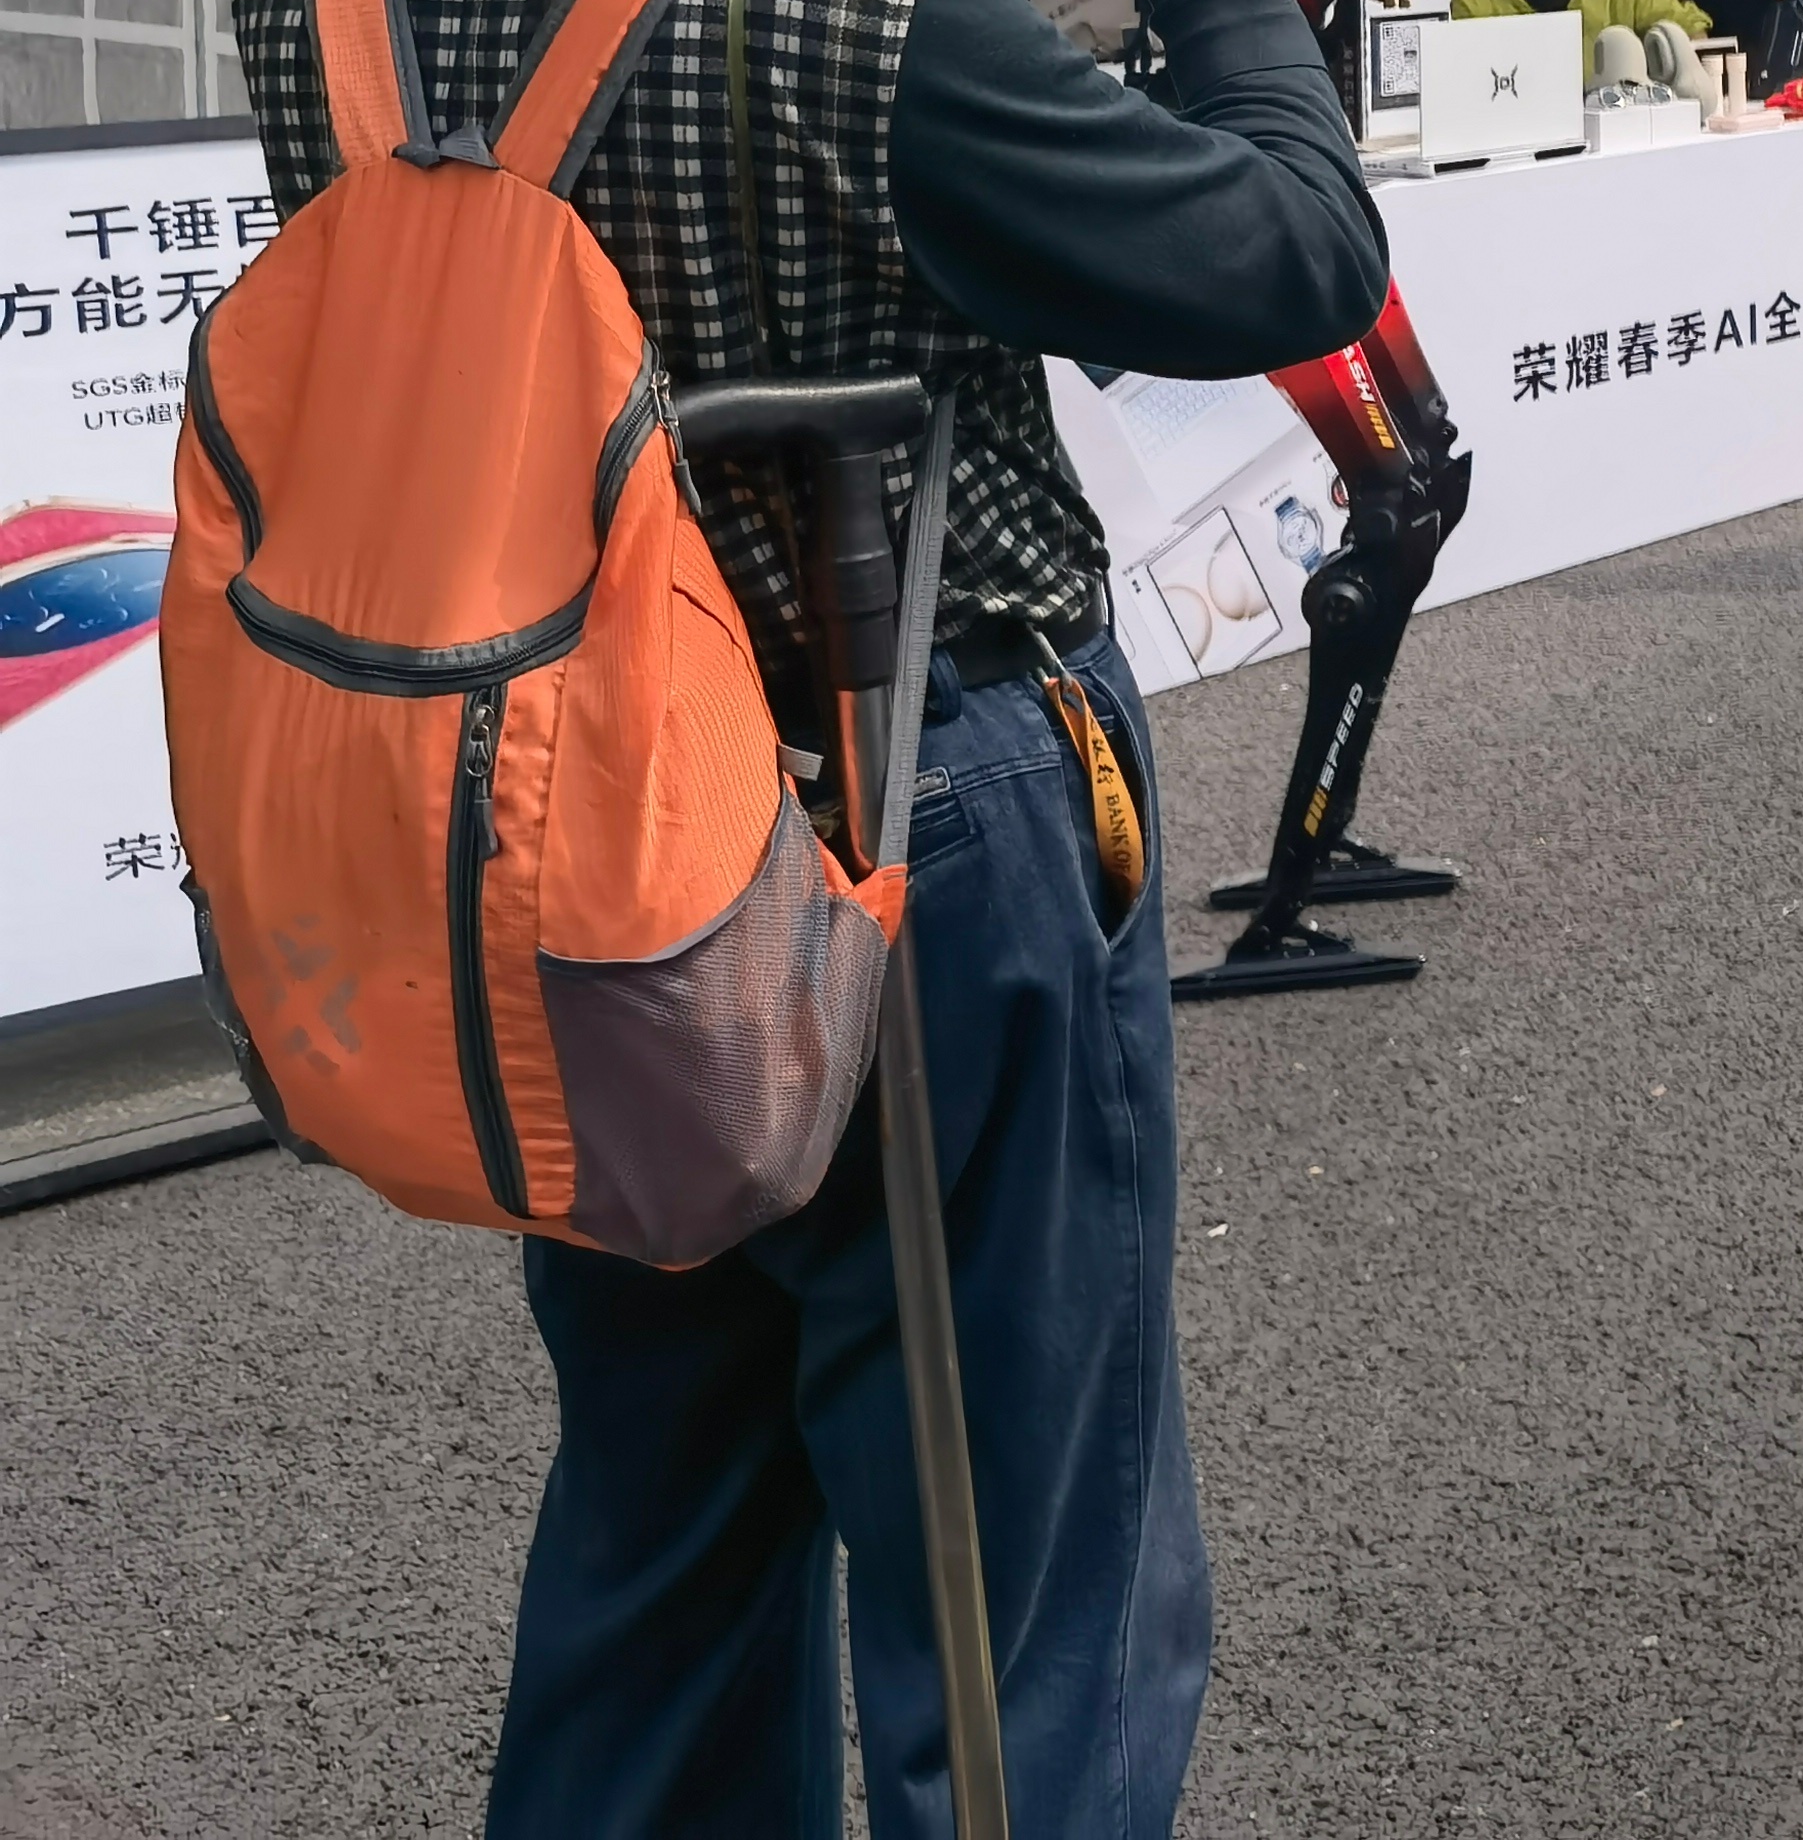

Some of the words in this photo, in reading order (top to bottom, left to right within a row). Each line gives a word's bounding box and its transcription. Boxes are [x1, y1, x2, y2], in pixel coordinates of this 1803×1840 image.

[0, 264, 250, 340] 方能无
[1321, 681, 1366, 791] SPEED
[1106, 792, 1130, 848] BANK
